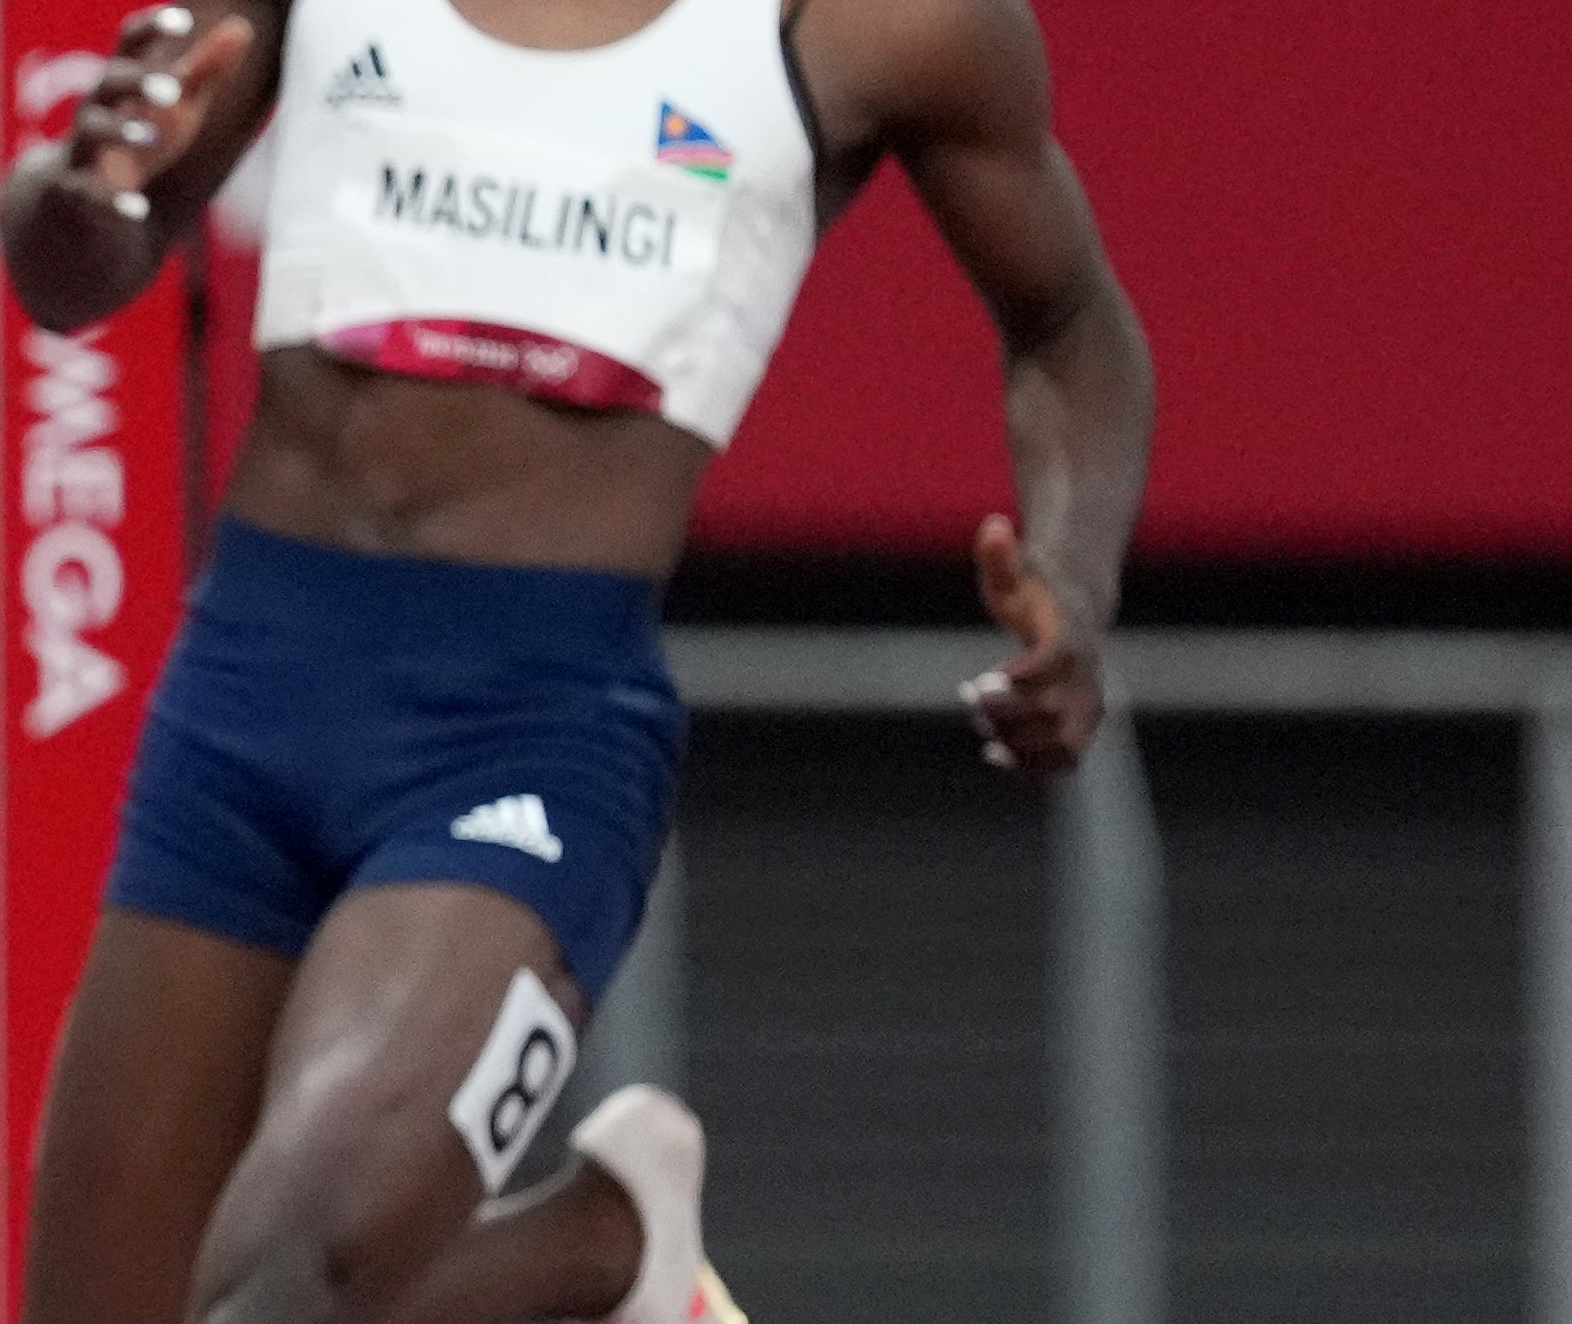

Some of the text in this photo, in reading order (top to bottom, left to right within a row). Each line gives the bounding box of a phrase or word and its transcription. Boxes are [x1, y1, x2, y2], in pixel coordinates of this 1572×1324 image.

[375, 164, 678, 269] MASILINGI
[16, 329, 125, 741] MEGA
[488, 1026, 560, 1154] 8
